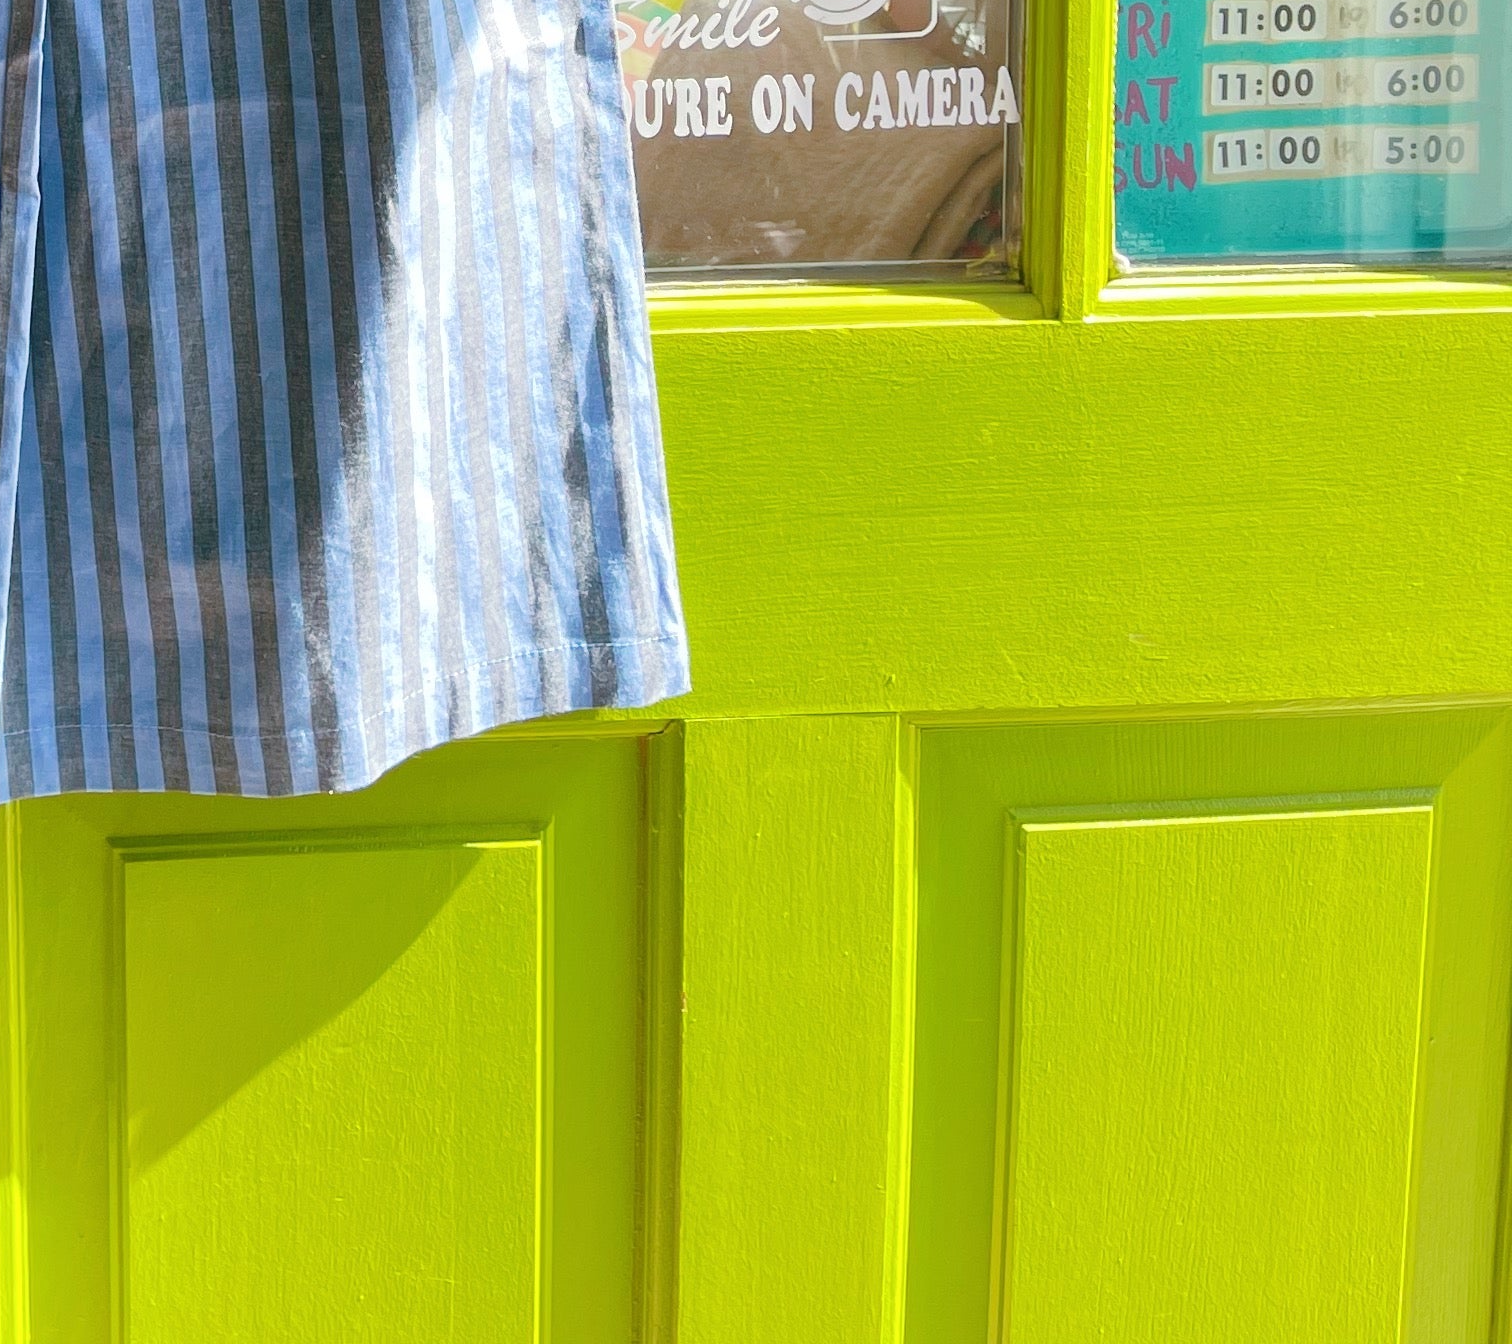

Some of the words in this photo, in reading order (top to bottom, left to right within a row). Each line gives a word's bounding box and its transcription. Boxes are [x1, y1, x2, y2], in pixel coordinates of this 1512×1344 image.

[1218, 4, 1316, 35] 11:00
[1390, 0, 1468, 29] 6:00
[751, 73, 816, 134] ON
[834, 66, 1021, 132] CAMERA
[1115, 76, 1179, 127] AT
[1218, 69, 1314, 101] 11:00
[1388, 64, 1465, 97] 6:00
[1218, 136, 1321, 168] 11:00
[1386, 135, 1465, 165] 5:00
